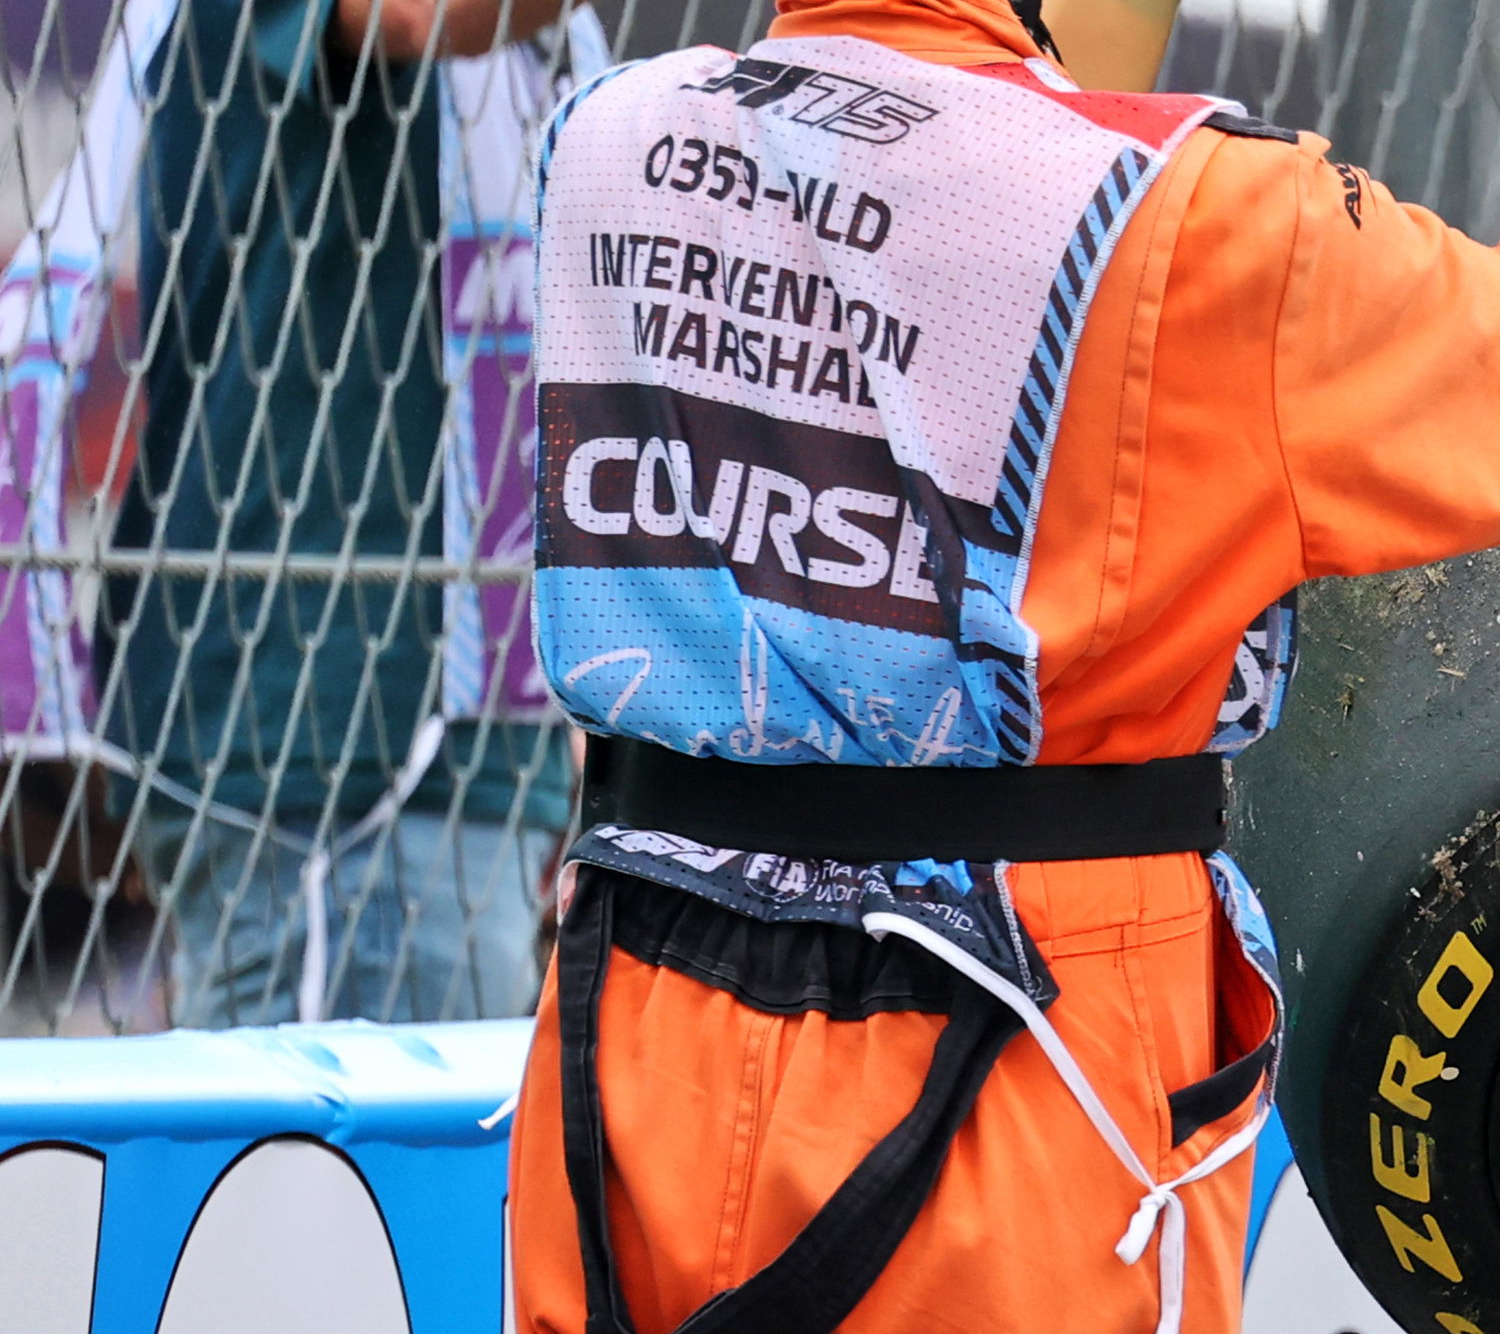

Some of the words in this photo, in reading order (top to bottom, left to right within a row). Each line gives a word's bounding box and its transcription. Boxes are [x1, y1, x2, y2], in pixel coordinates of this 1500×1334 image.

[633, 300, 878, 409] MARSHAL
[562, 435, 941, 604] COURSE
[1369, 930, 1494, 1283] ZERO
